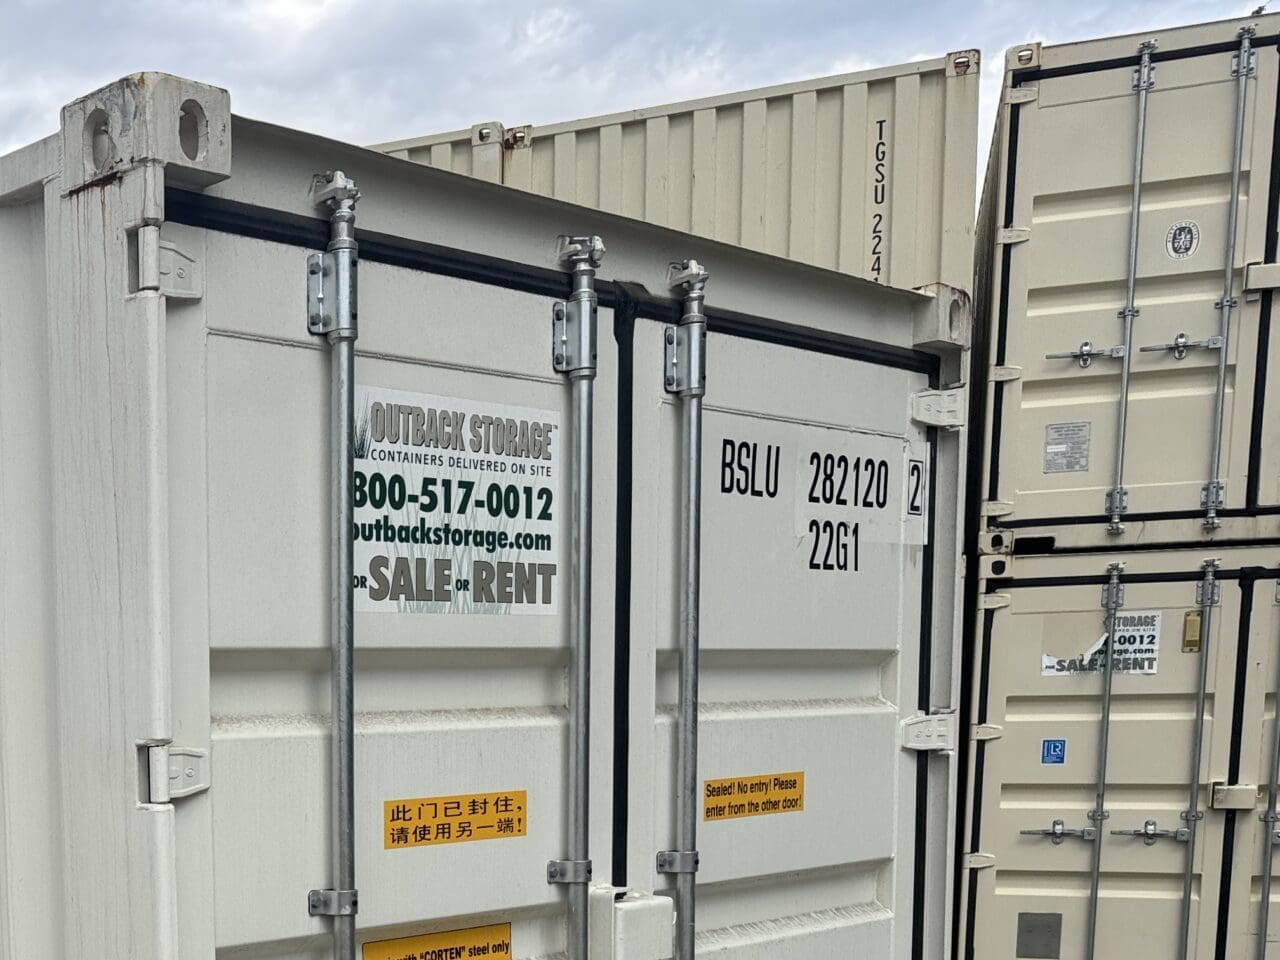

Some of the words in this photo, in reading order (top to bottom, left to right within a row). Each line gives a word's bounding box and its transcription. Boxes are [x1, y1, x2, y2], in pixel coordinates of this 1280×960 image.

[874, 119, 886, 204] TGSU
[871, 213, 883, 283] 224
[370, 401, 465, 451] OUTBACK
[469, 414, 552, 460] STORAGE
[371, 448, 444, 467] CONTAINERS
[448, 457, 506, 472] DELIVERED
[511, 462, 525, 475] ON
[530, 465, 551, 477] SITE
[720, 438, 780, 498] BSLU
[808, 451, 888, 508] 282120
[909, 463, 921, 512] 2
[353, 471, 552, 521] 800-517-0012
[808, 519, 859, 572] 22G1
[353, 575, 368, 589] OR
[369, 555, 452, 602] SALE
[455, 578, 470, 591] OR
[473, 560, 557, 604] RENT
[1113, 615, 1156, 628] TORAGE
[1056, 659, 1098, 672] SALE
[1111, 657, 1156, 671] RENT
[705, 805, 726, 818] enter
[728, 802, 745, 815] from
[748, 800, 759, 813] the
[761, 798, 780, 811] other
[782, 794, 802, 808] door!
[706, 782, 735, 797] Sealed!
[737, 781, 748, 794] No
[750, 779, 771, 795] entry!
[773, 777, 797, 790] Please
[468, 942, 489, 957] steel
[492, 939, 510, 955] only
